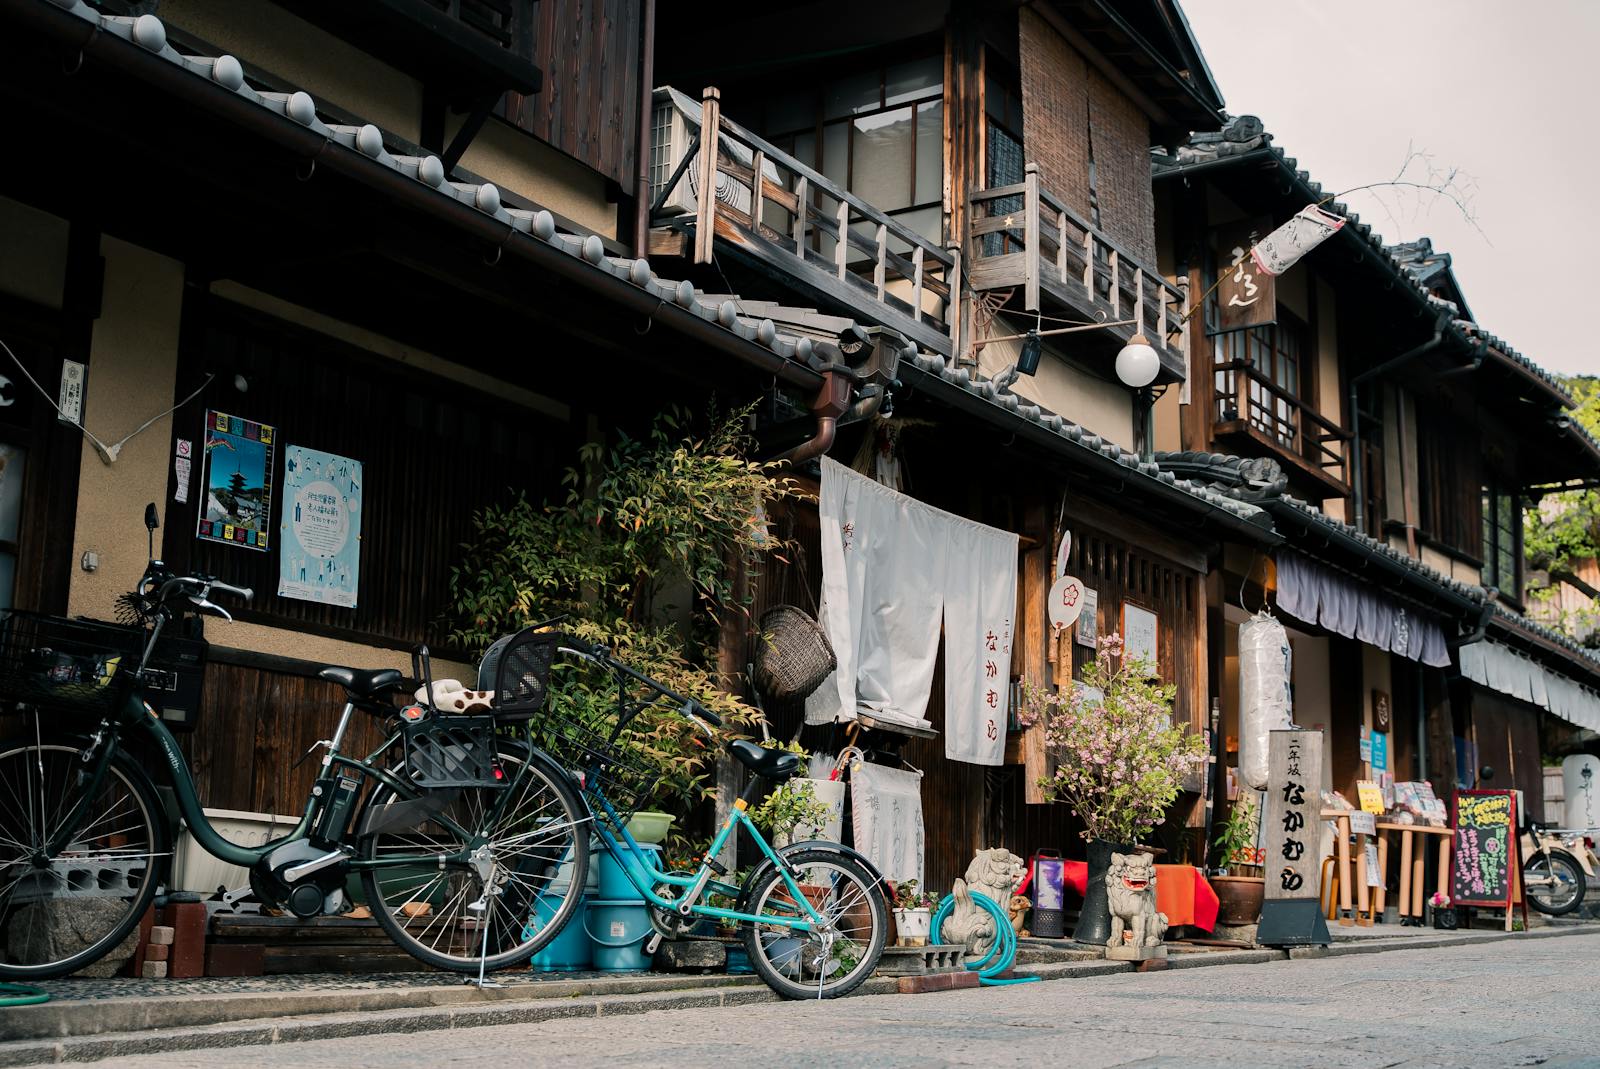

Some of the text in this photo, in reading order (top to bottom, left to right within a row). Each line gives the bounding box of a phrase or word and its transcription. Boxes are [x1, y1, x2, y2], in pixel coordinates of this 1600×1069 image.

[985, 629, 998, 742] なかむら
[1287, 739, 1301, 776] 二年坂
[1280, 780, 1305, 892] なかむら
